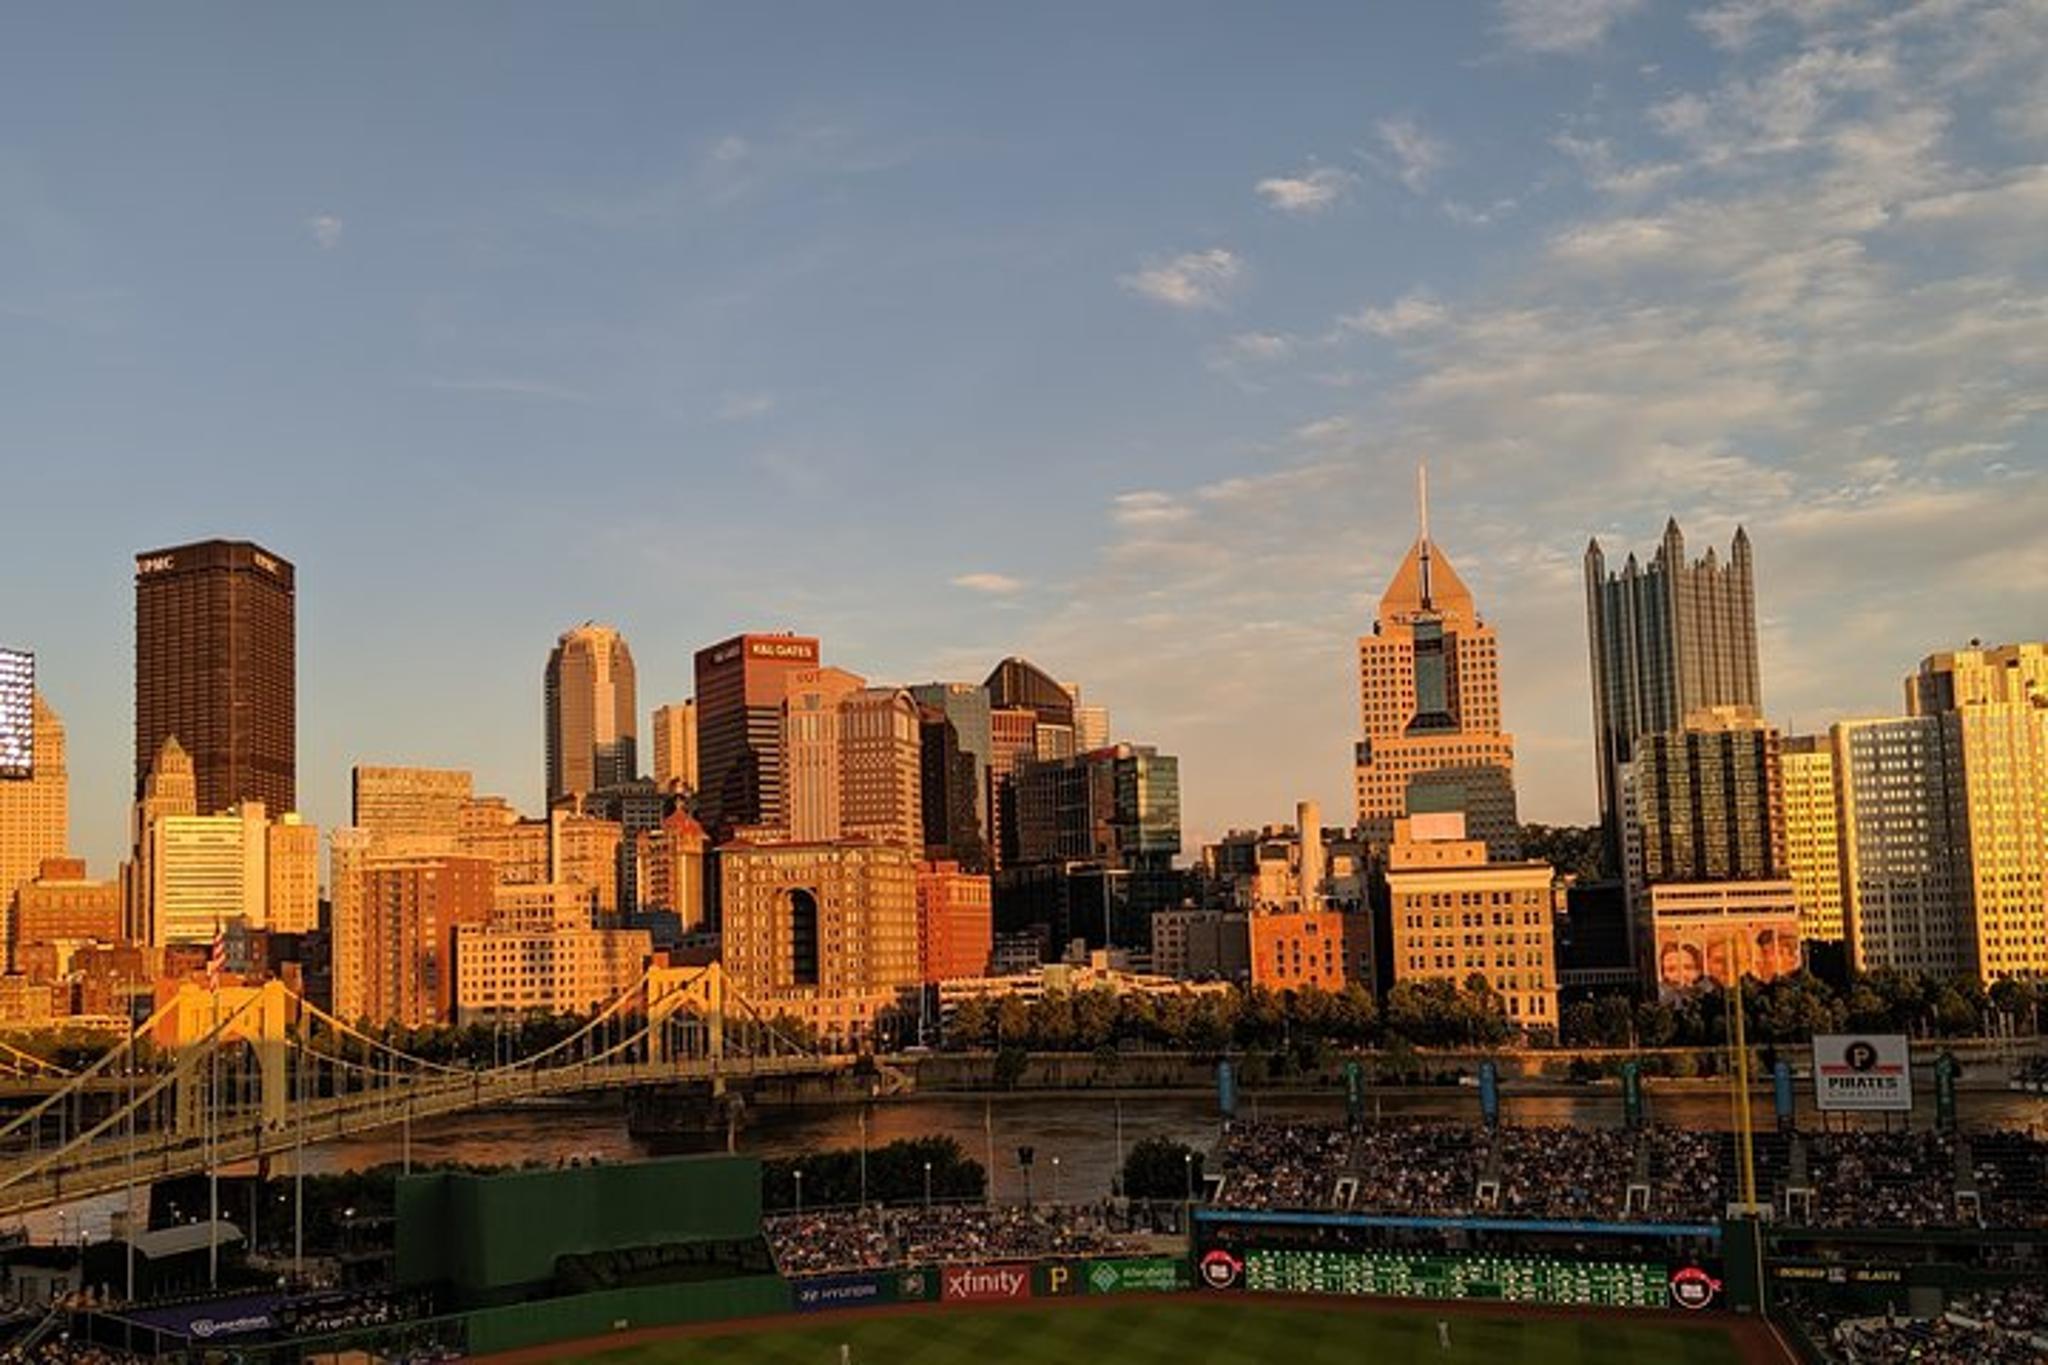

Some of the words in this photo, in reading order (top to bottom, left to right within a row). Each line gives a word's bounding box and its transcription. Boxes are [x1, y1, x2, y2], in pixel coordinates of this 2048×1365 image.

[1853, 1048, 1869, 1067] P
[1828, 1077, 1898, 1089] PIRATES
[948, 1269, 1025, 1298] xfinity
[1051, 1266, 1068, 1292] P
